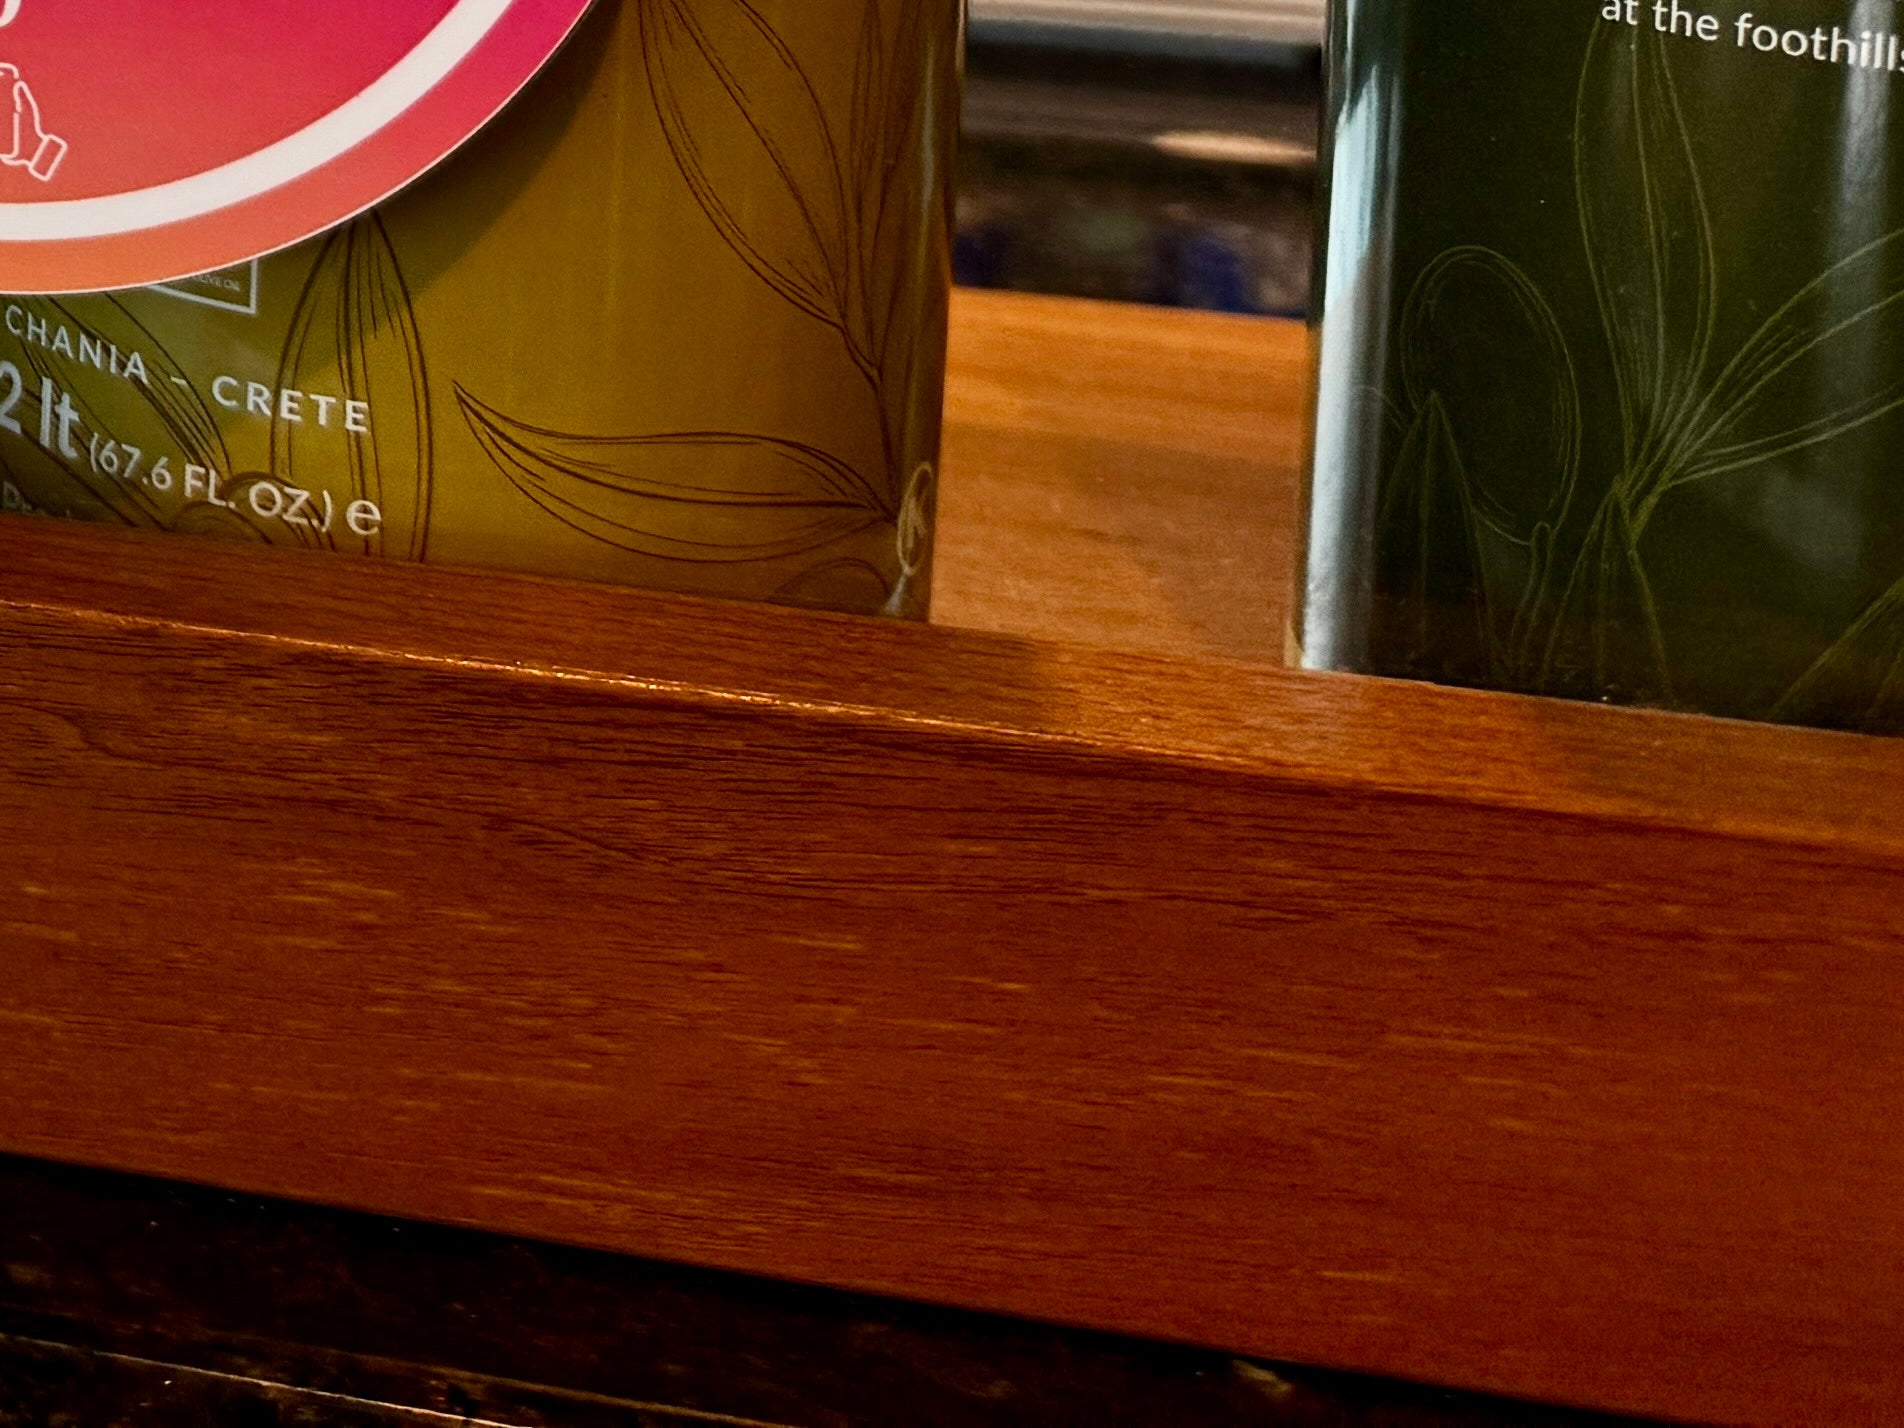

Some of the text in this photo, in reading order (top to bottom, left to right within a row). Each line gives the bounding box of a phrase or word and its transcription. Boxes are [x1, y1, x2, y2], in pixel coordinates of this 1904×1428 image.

[5, 305, 149, 386] CHANIA
[211, 374, 369, 435] CRETE
[88, 431, 174, 492] (67.6
[182, 462, 236, 511] FL.
[246, 483, 333, 534] OZ.)
